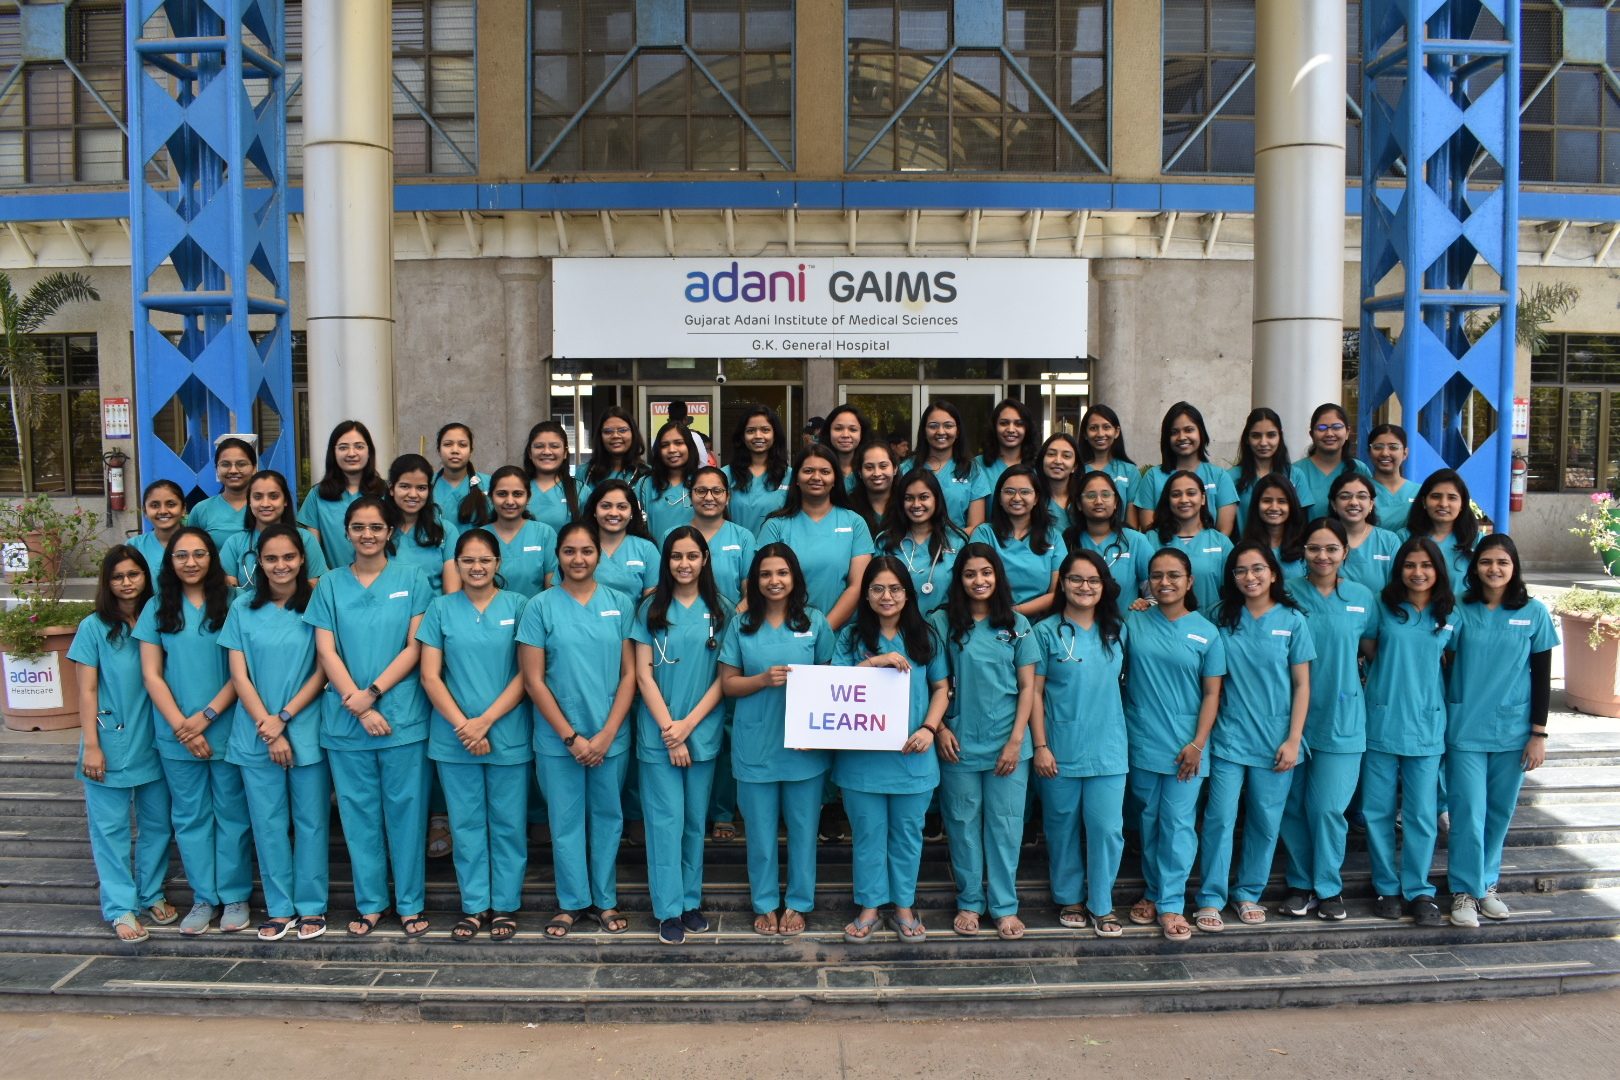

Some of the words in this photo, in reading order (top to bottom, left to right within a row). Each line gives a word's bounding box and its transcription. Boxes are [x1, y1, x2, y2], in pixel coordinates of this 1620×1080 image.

[684, 261, 806, 303] adani
[828, 270, 958, 303] GAIMS
[684, 314, 730, 328] Gujarat
[734, 314, 770, 326] Adani
[774, 314, 828, 326] Institute
[831, 314, 846, 326] of
[849, 314, 898, 326] Medical
[902, 314, 958, 326] Sciences
[752, 339, 778, 351] G.K.
[782, 339, 832, 351] General
[836, 339, 890, 353] Hospital
[655, 404, 706, 414] WING
[10, 667, 53, 683] adani
[11, 687, 54, 695] Healthcare
[830, 683, 867, 703] WE
[808, 711, 886, 732] LEARN
